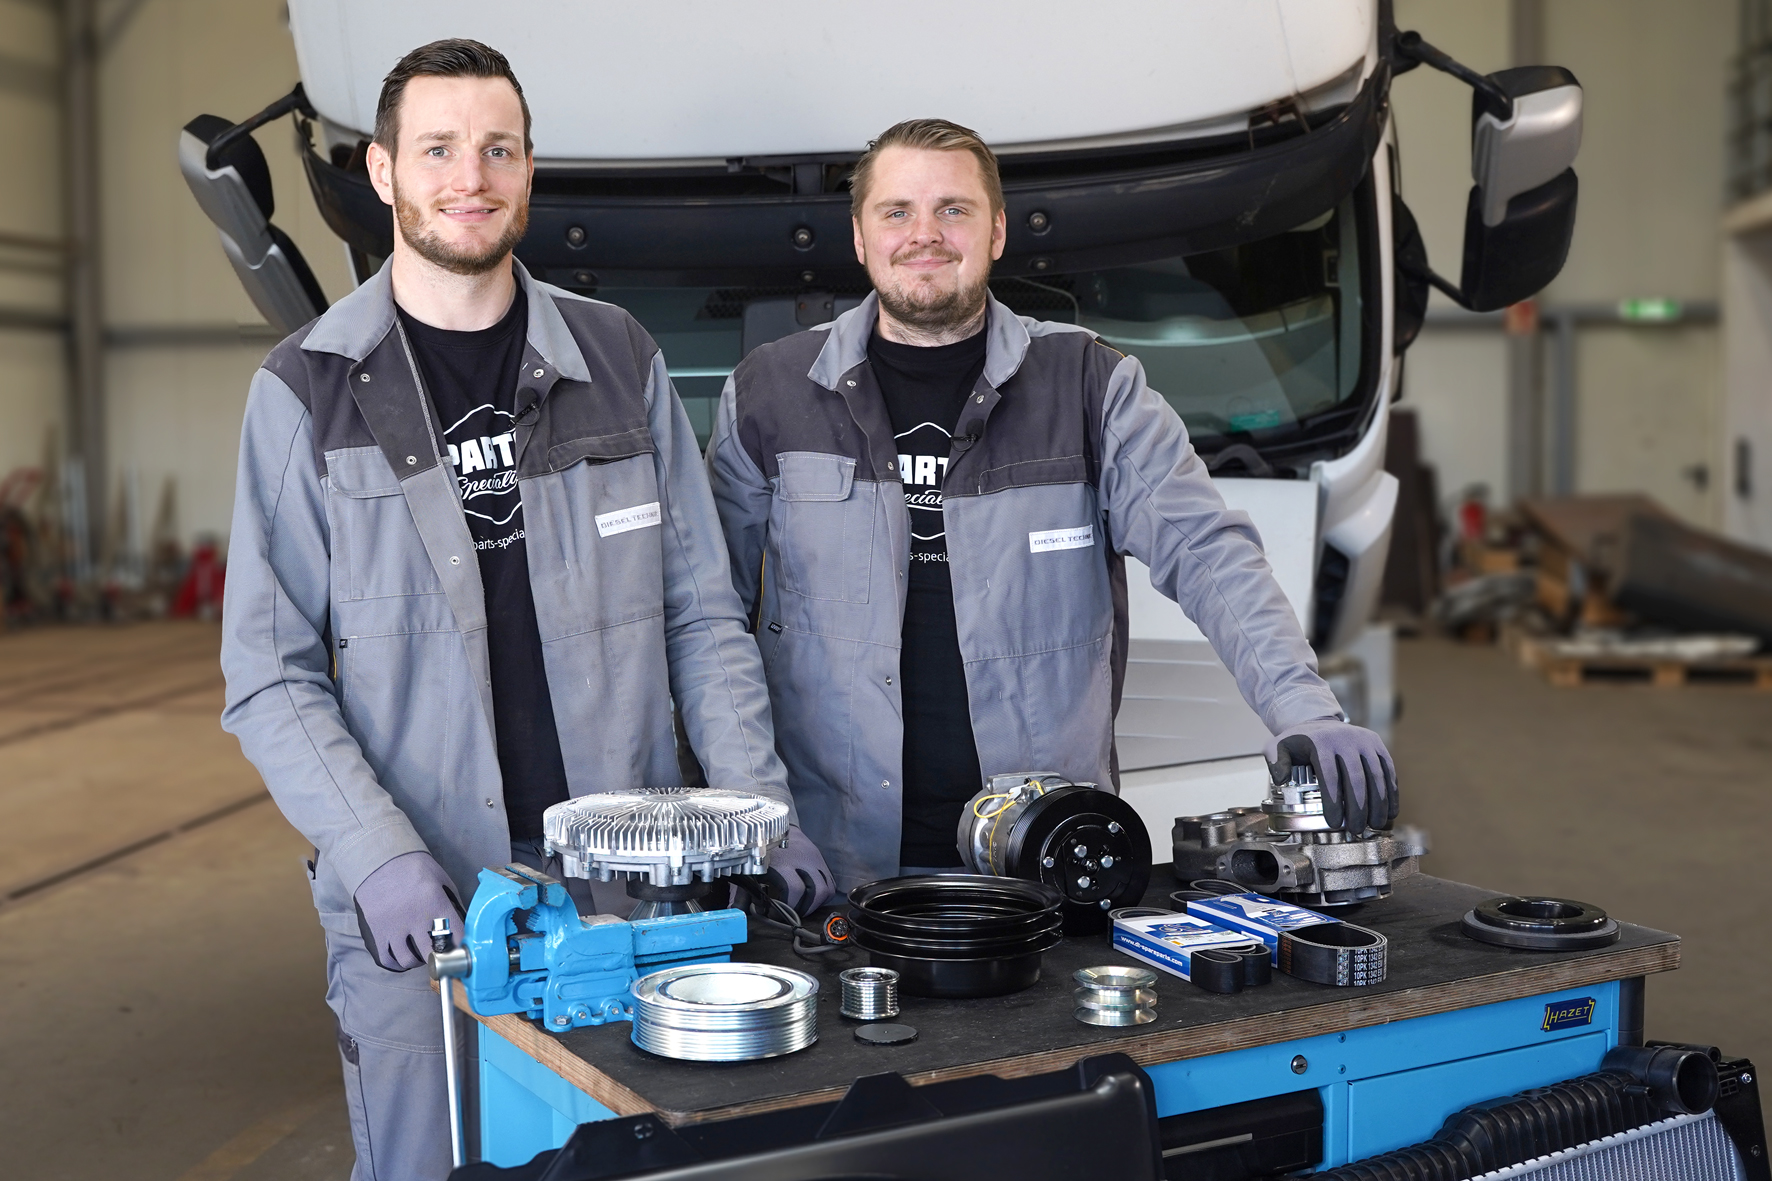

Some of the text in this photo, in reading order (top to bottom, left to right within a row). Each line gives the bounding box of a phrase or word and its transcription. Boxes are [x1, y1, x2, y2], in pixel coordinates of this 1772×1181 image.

[447, 433, 516, 475] PART
[600, 517, 631, 529] DIESEL
[1034, 537, 1066, 545] DIESEL
[1120, 935, 1183, 967] www.dt-spareparts.com
[1354, 954, 1368, 963] 10PK
[1354, 963, 1367, 971] 10PK
[1353, 971, 1367, 980] 10PK
[1549, 1006, 1590, 1024] HAZET
